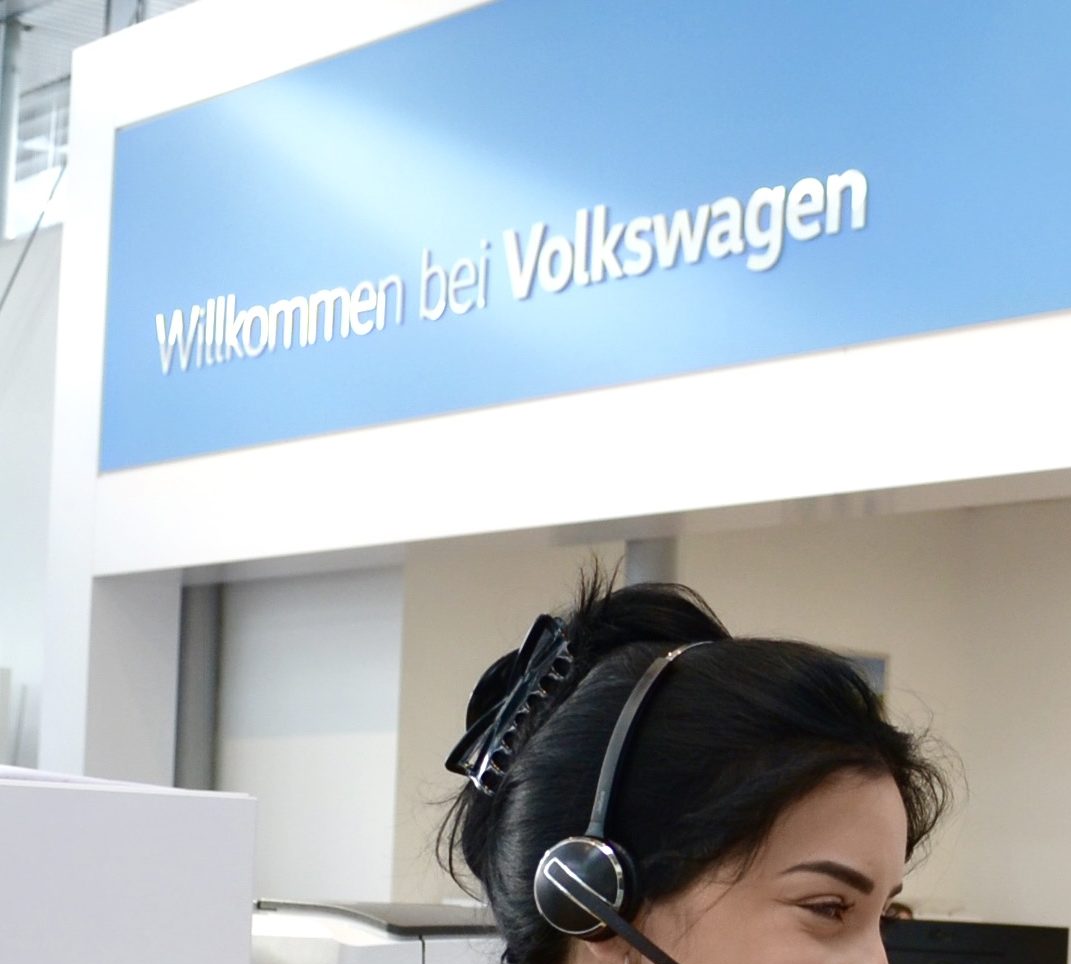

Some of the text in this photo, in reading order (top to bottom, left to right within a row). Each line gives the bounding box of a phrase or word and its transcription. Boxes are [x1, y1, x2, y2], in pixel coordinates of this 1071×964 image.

[155, 169, 868, 375] Willkommen bei Volkswagen
